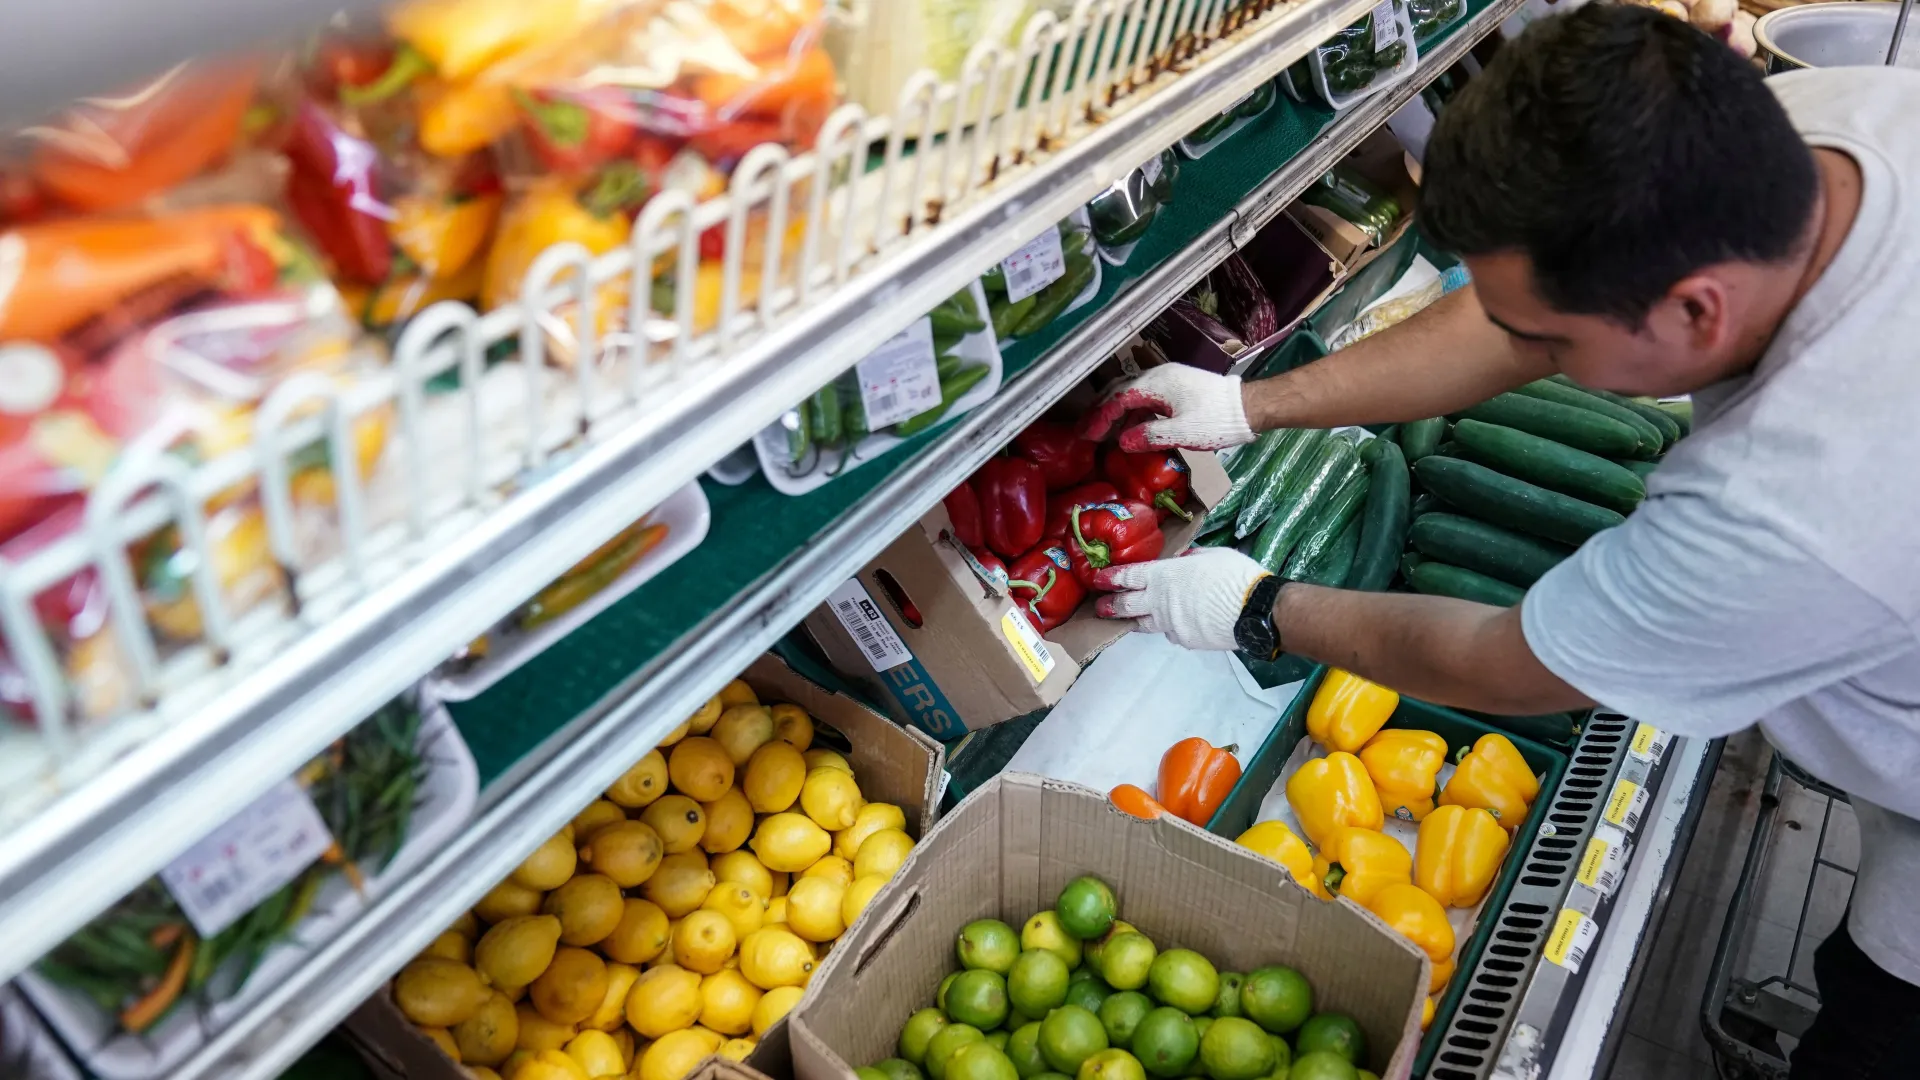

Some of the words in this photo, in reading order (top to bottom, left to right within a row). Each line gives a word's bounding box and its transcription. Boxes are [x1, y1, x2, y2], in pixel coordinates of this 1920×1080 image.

[878, 620, 890, 635] PRODUCT
[893, 641, 904, 655] CANADA
[1022, 647, 1034, 664] PEPPER
[888, 662, 952, 734] ERS
[1636, 790, 1645, 804] $3.99
[1609, 846, 1619, 861] $3.99
[1585, 866, 1593, 880] ORANGE
[1590, 854, 1598, 868] PEPPER
[1581, 920, 1592, 936] $3.99
[1554, 940, 1563, 956] ORANGE
[1561, 927, 1570, 941] PEPPER
